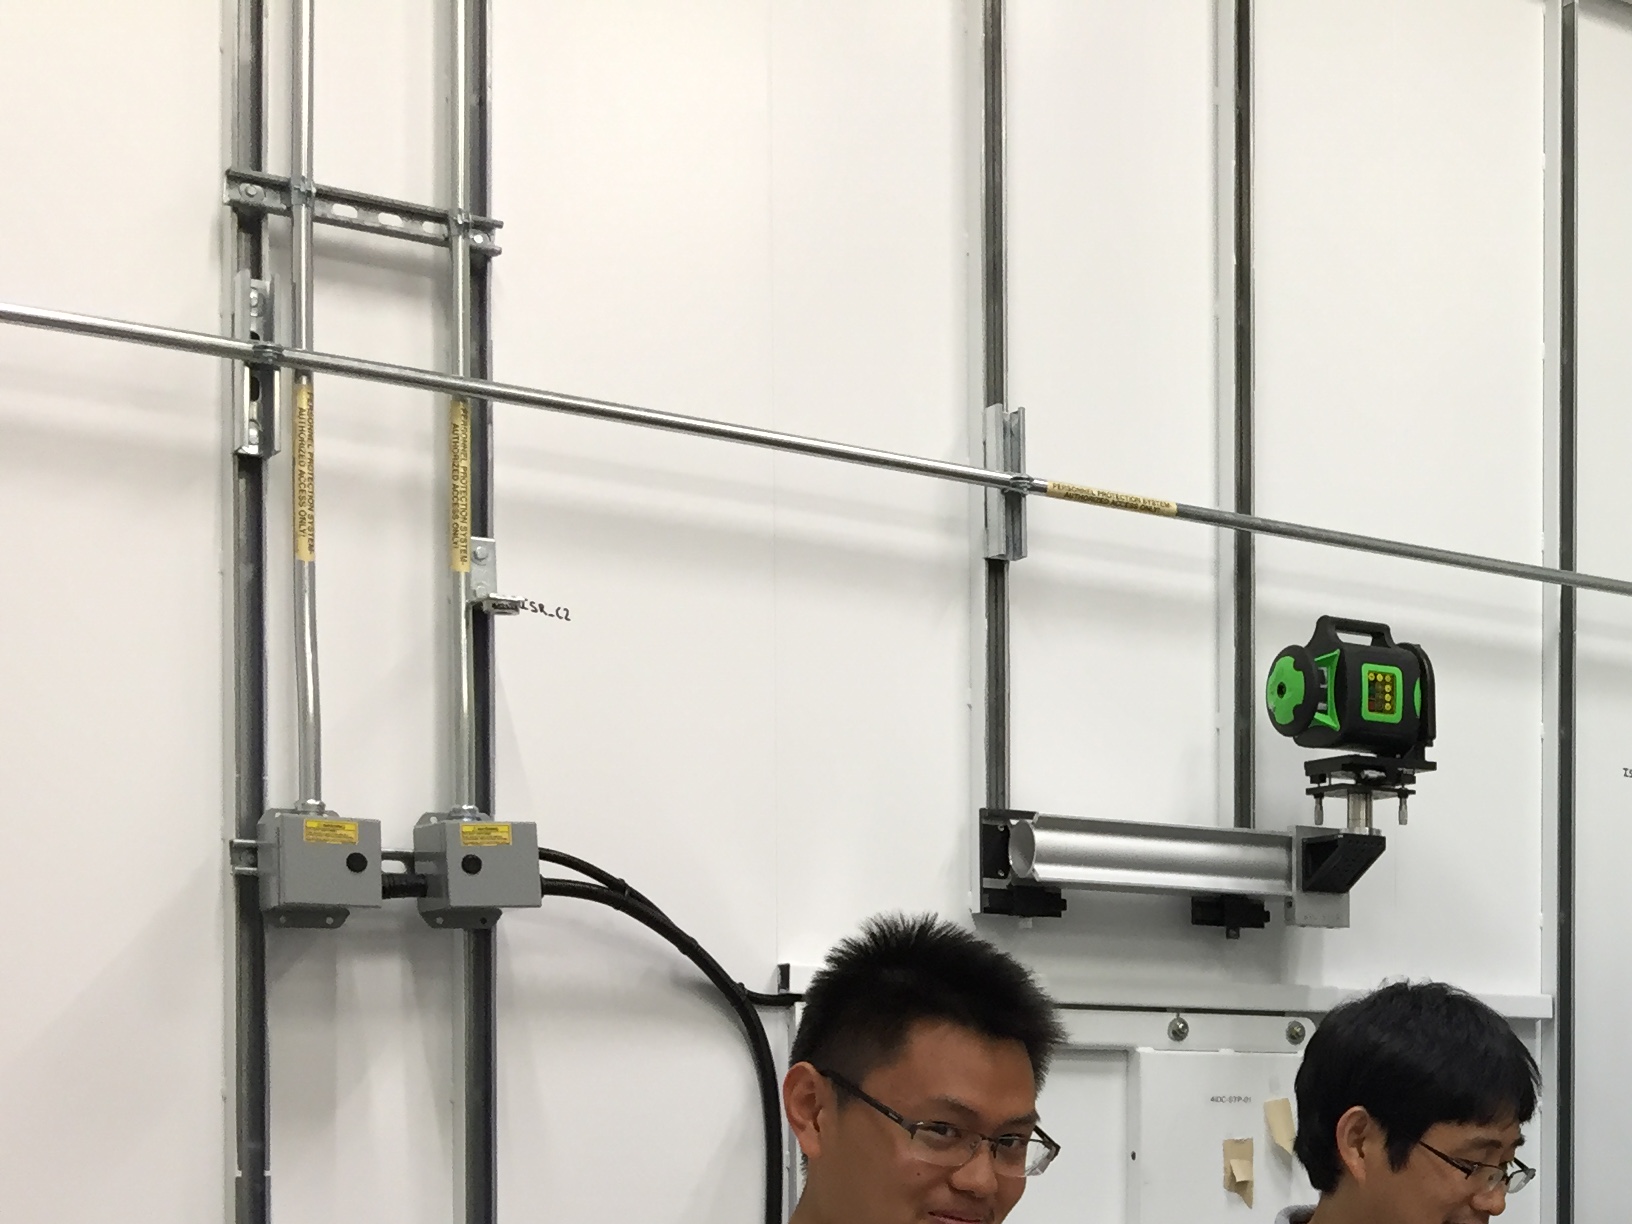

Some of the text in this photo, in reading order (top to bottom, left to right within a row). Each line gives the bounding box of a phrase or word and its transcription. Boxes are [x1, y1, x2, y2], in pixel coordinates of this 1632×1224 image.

[298, 407, 307, 467] AUTHORIZED
[451, 423, 459, 481] AUTHORIZED
[298, 469, 307, 508] ACCESS
[451, 484, 459, 519] ACCESS
[460, 466, 468, 524] PROTECTION
[1110, 500, 1139, 510] ACCESS
